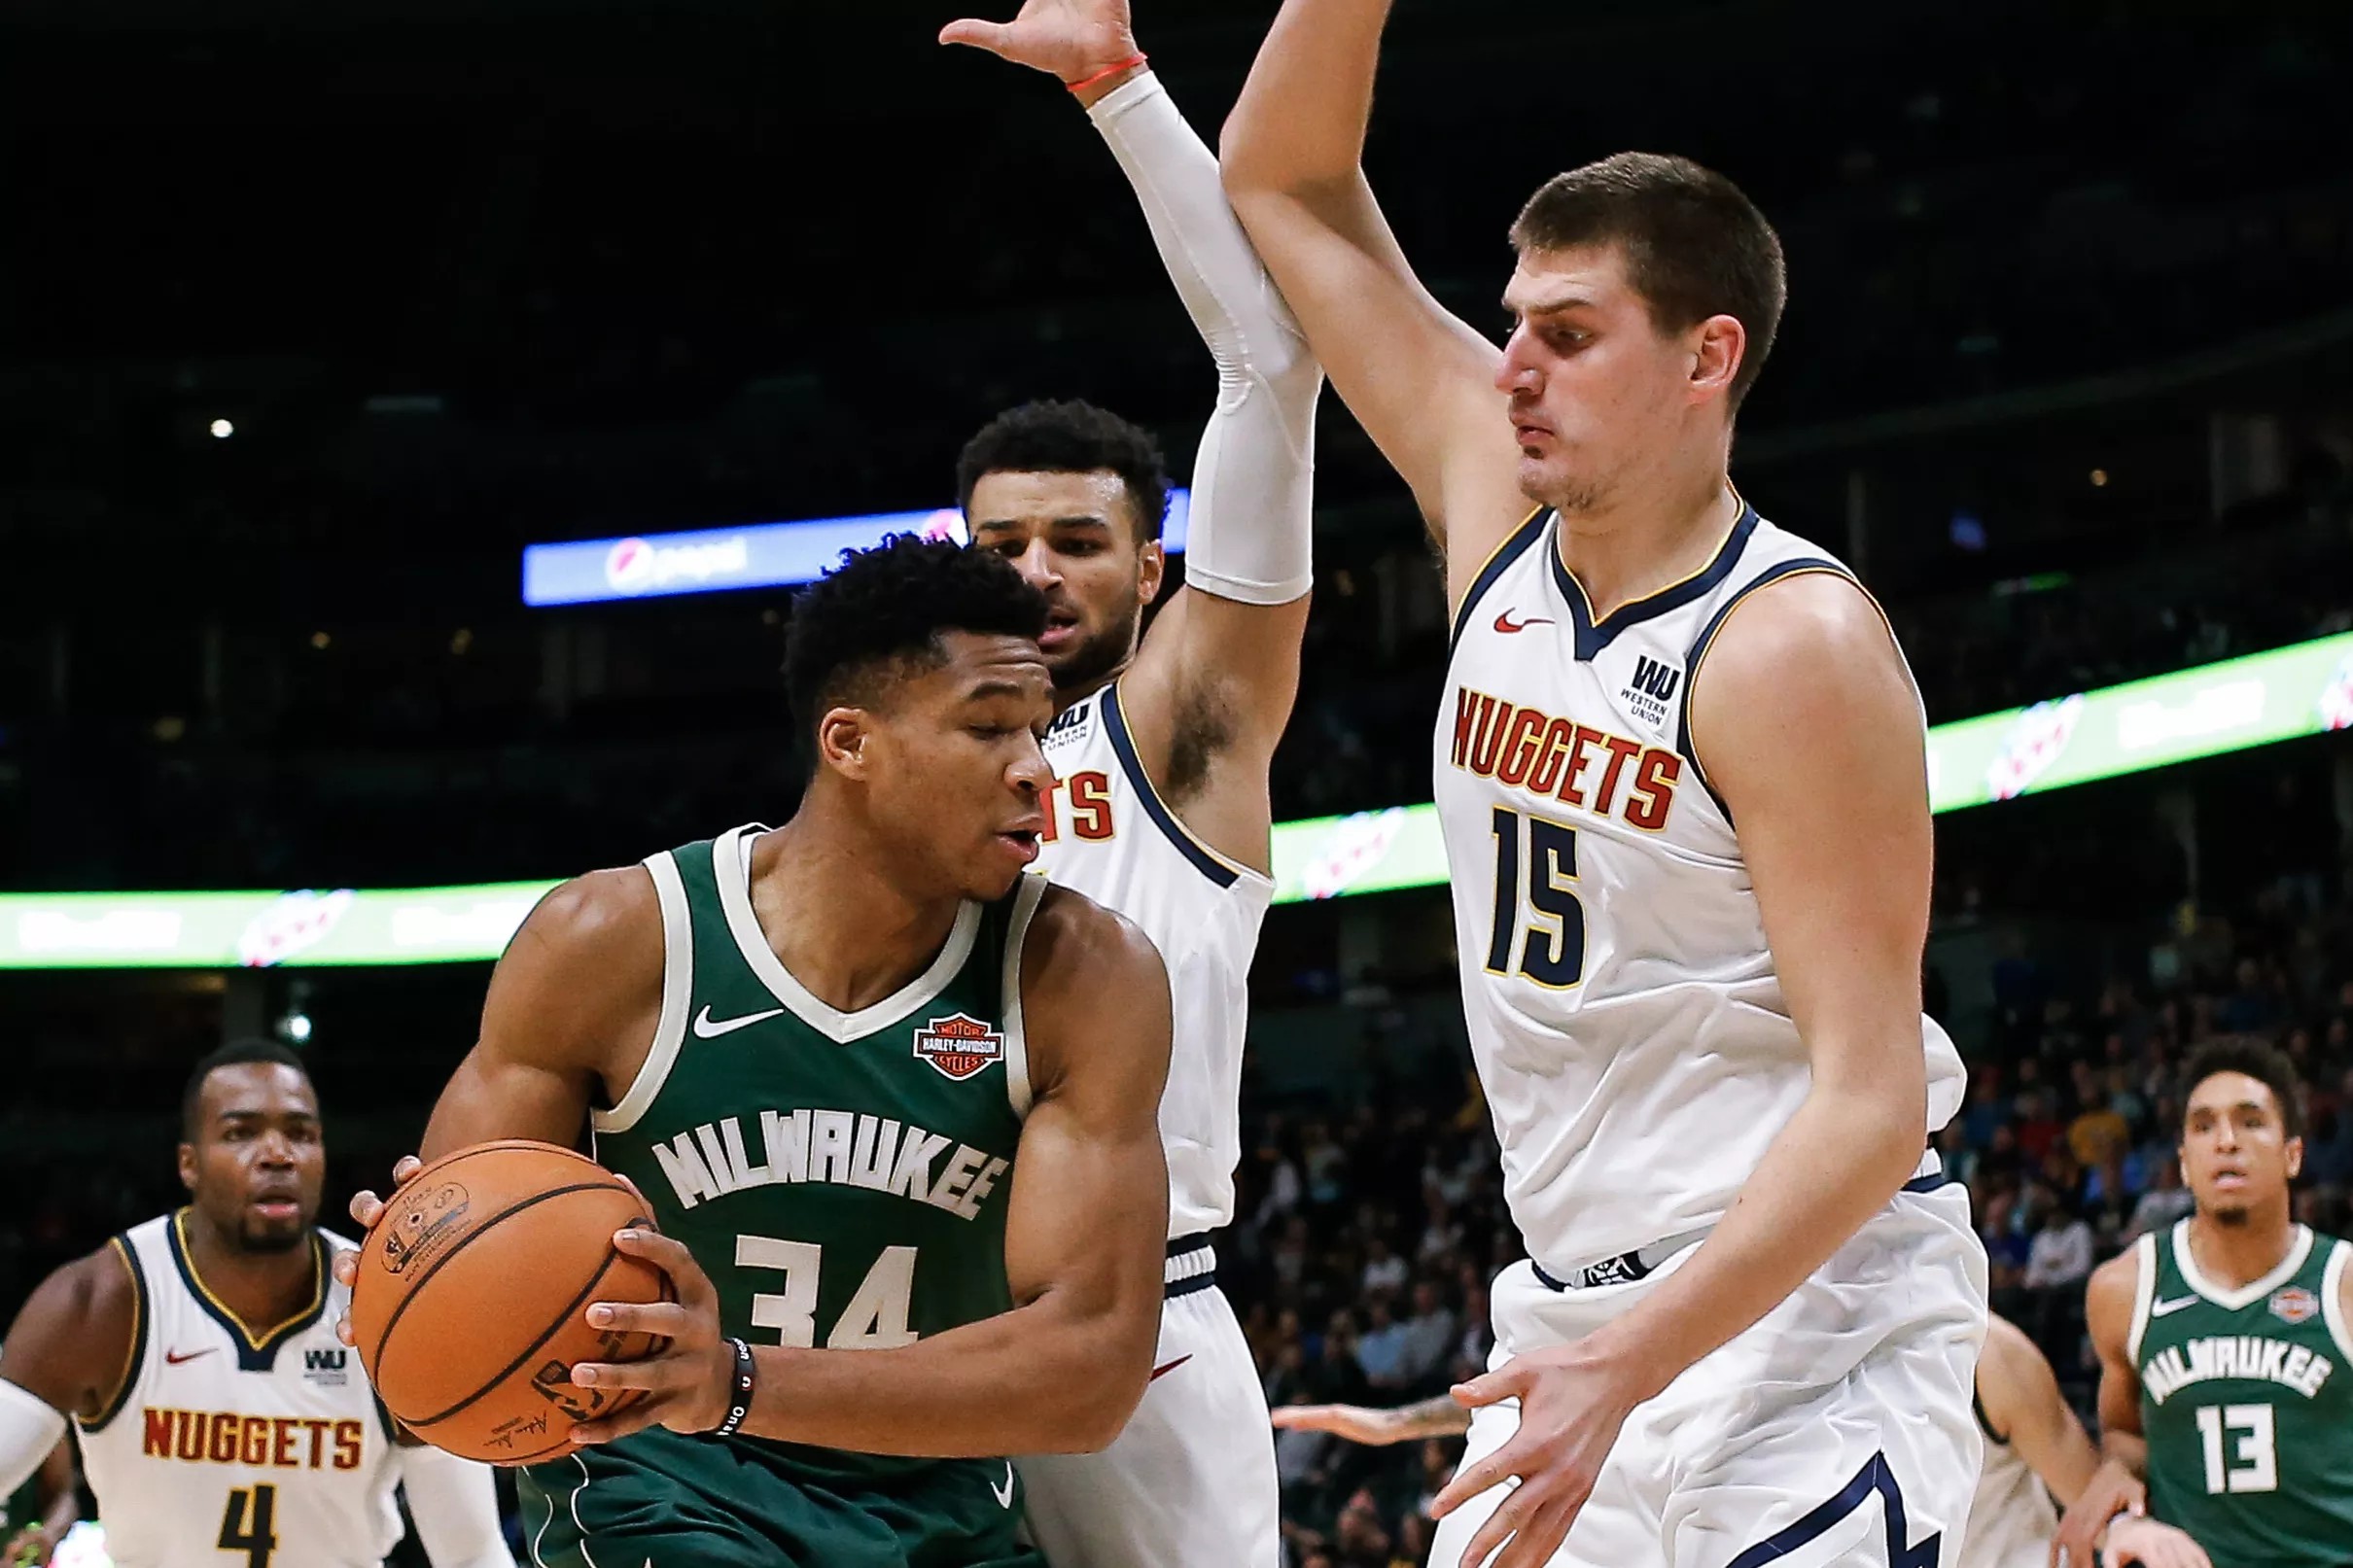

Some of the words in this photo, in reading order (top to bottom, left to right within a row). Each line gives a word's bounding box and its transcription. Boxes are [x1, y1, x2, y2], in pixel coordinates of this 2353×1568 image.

[1621, 688, 1668, 715] WESTERN
[1632, 654, 1680, 701] WU
[1048, 732, 1087, 750] UNION
[1631, 706, 1663, 725] UNION
[1452, 685, 1684, 832] NUGGETS
[1485, 805, 1587, 991] 15
[940, 1022, 980, 1036] MOTOR
[939, 1056, 979, 1072] CYCLES
[651, 1109, 1009, 1221] MILWAUKEE
[735, 1235, 919, 1350] 34
[2141, 1336, 2333, 1407] MILWAUKEE
[143, 1408, 363, 1470] NUGGETS
[2195, 1403, 2279, 1495] 13
[216, 1481, 279, 1568] 4
